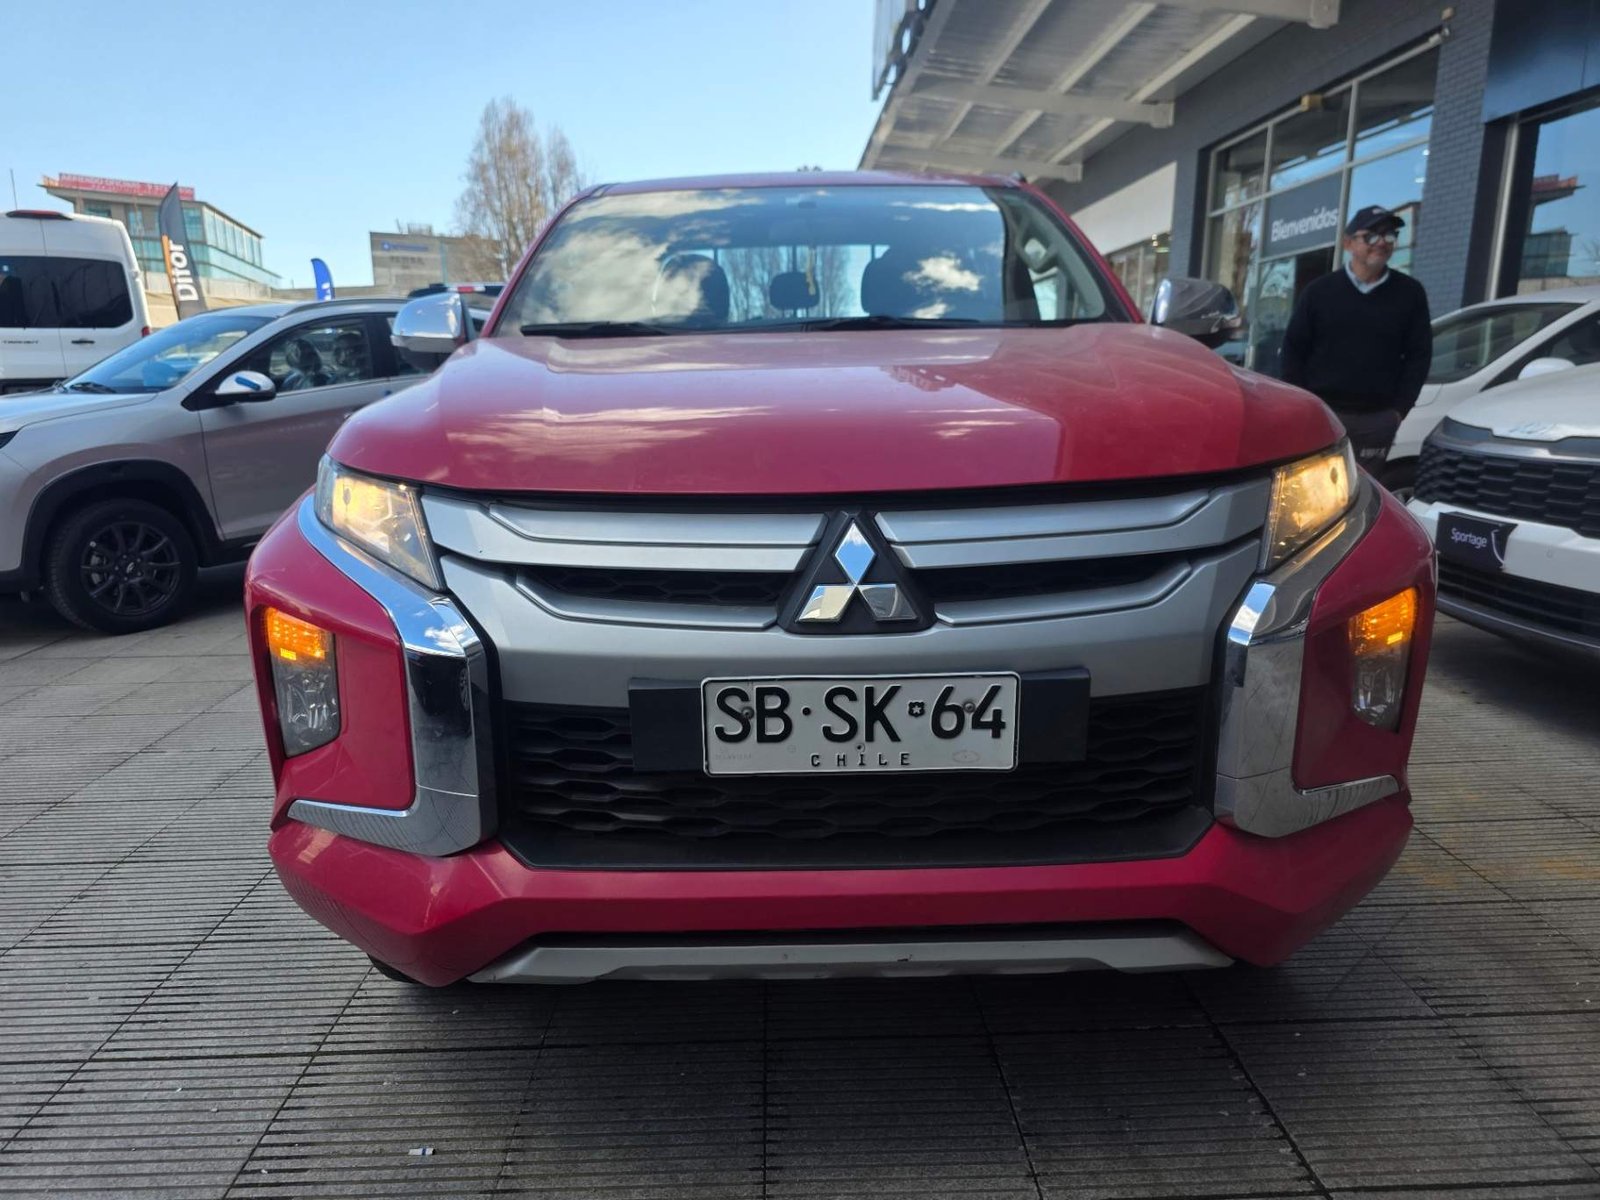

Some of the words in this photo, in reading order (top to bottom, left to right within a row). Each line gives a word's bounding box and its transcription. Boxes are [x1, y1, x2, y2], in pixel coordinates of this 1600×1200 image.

[1271, 206, 1339, 242] Bienvenidos
[1451, 528, 1487, 549] Sportage
[811, 753, 911, 767] CHILE
